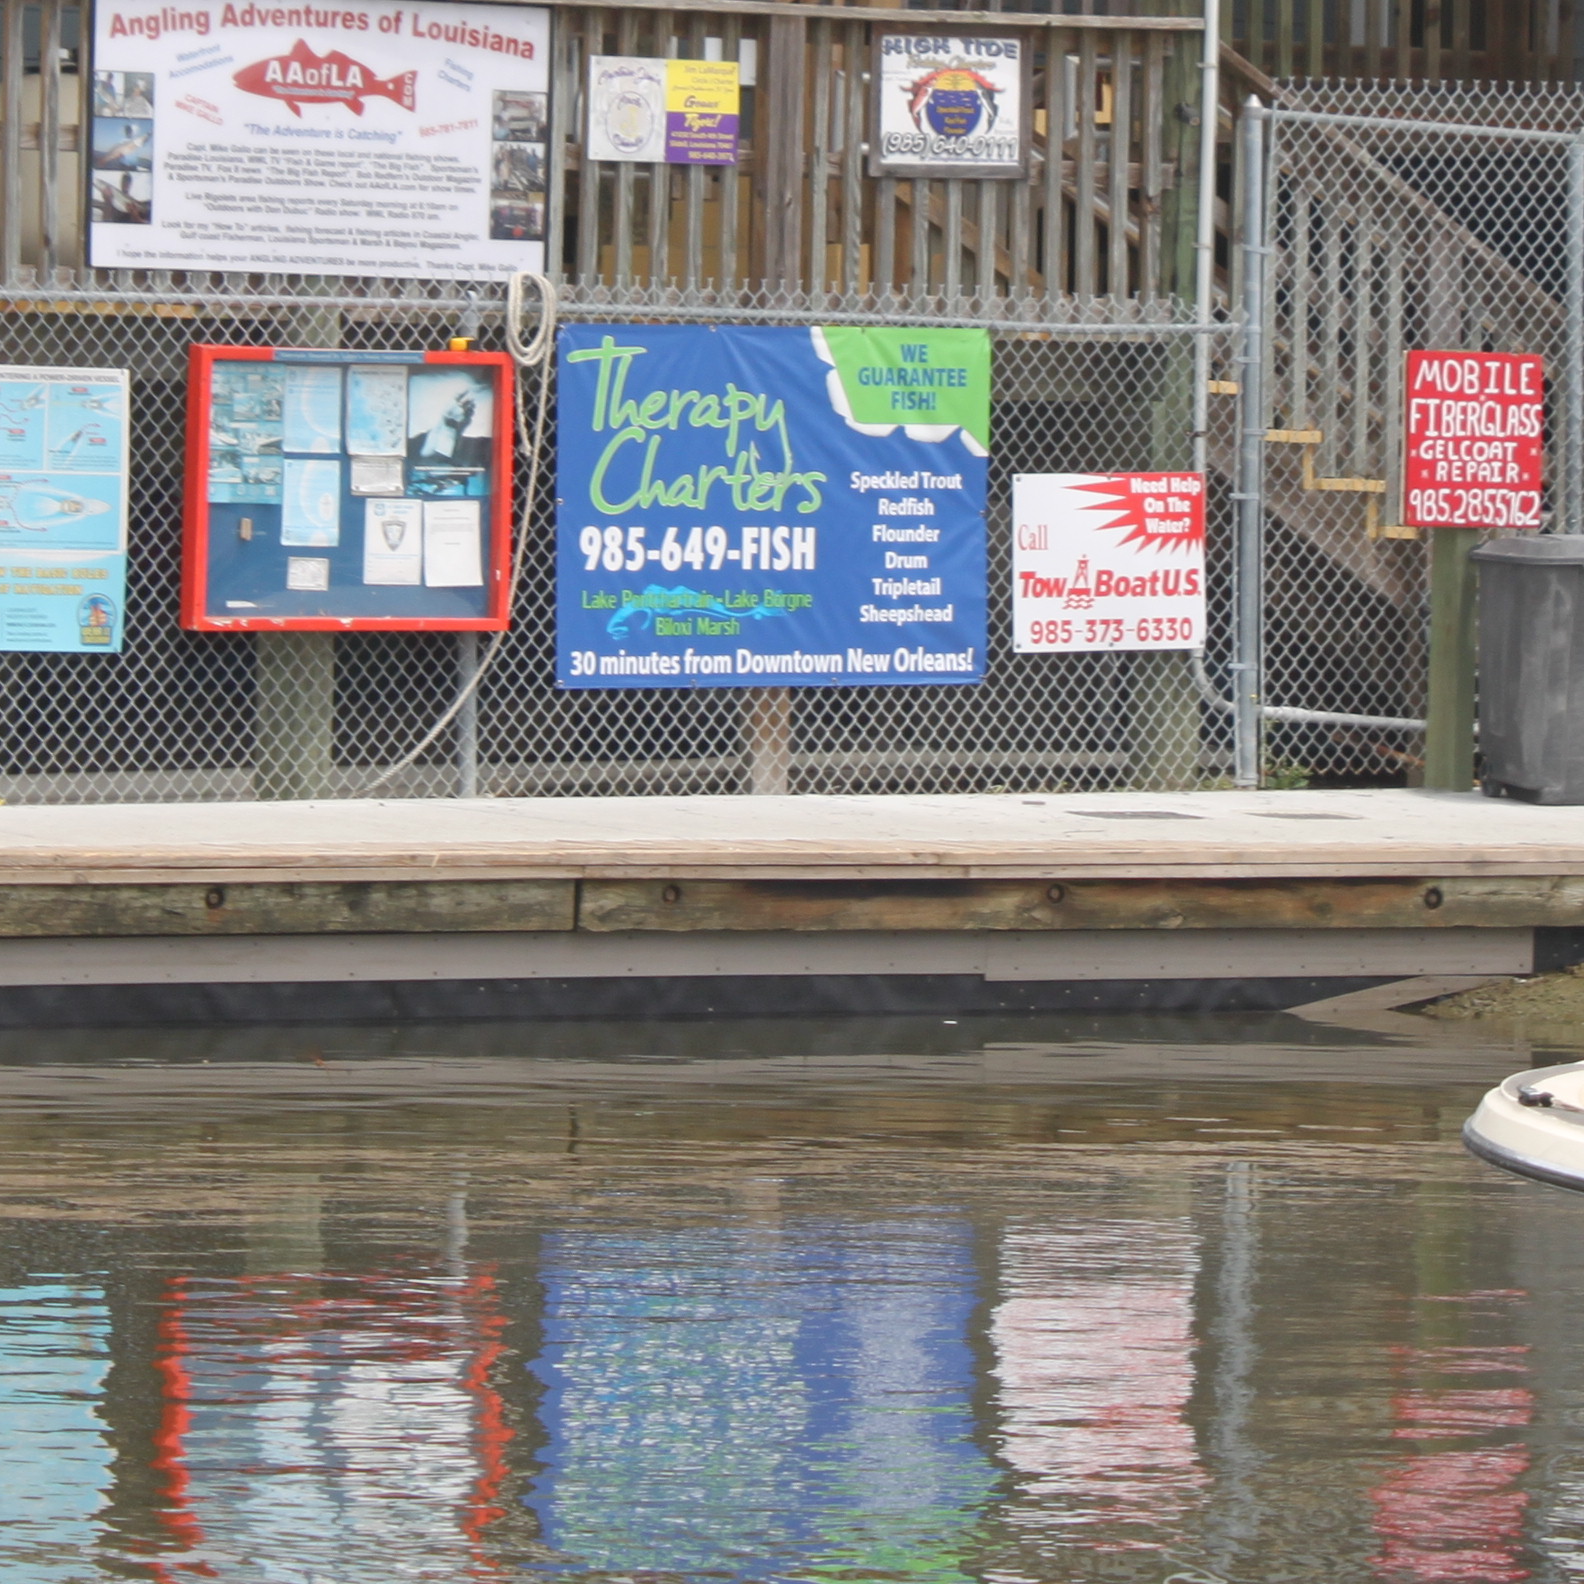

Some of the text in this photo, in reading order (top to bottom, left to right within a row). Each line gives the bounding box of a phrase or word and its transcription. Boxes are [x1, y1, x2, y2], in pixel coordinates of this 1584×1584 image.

[110, 3, 535, 61] Angling Adventures of Louisiana
[882, 37, 1018, 59] HIGH TIDE
[265, 61, 364, 89] AAofLA
[273, 125, 331, 139] Adventure
[882, 132, 930, 159] (985)
[901, 344, 928, 363] WE
[858, 367, 967, 387] GUARANTEE
[1414, 359, 1535, 395] MOBILE
[567, 335, 792, 472] Therapy
[891, 391, 937, 411] FISH!
[1410, 398, 1542, 437] FIBERGLASS
[1420, 440, 1518, 461] GELCOAT
[590, 426, 827, 515] Charters
[1436, 462, 1520, 483] REPAIR
[850, 471, 963, 493] Speckled Trout
[1130, 477, 1201, 496] Need Help
[878, 498, 934, 516] Redfish
[1143, 497, 1191, 513] On The
[872, 524, 940, 543] Flounder
[1018, 524, 1048, 550] Call
[1144, 518, 1191, 534] Water?
[579, 526, 815, 571] 985-649-FISH
[885, 551, 928, 569] Drum
[871, 577, 941, 599] Tripletail
[1019, 571, 1068, 598] Tow
[582, 590, 616, 608] Lake
[763, 588, 813, 611] Borgne
[859, 603, 953, 626] Sheepshead
[656, 617, 740, 635] Biloxi Marsh
[1030, 617, 1193, 644] 985-373-6330
[570, 647, 974, 675] 30 minutes from Downtown New Orleans!
